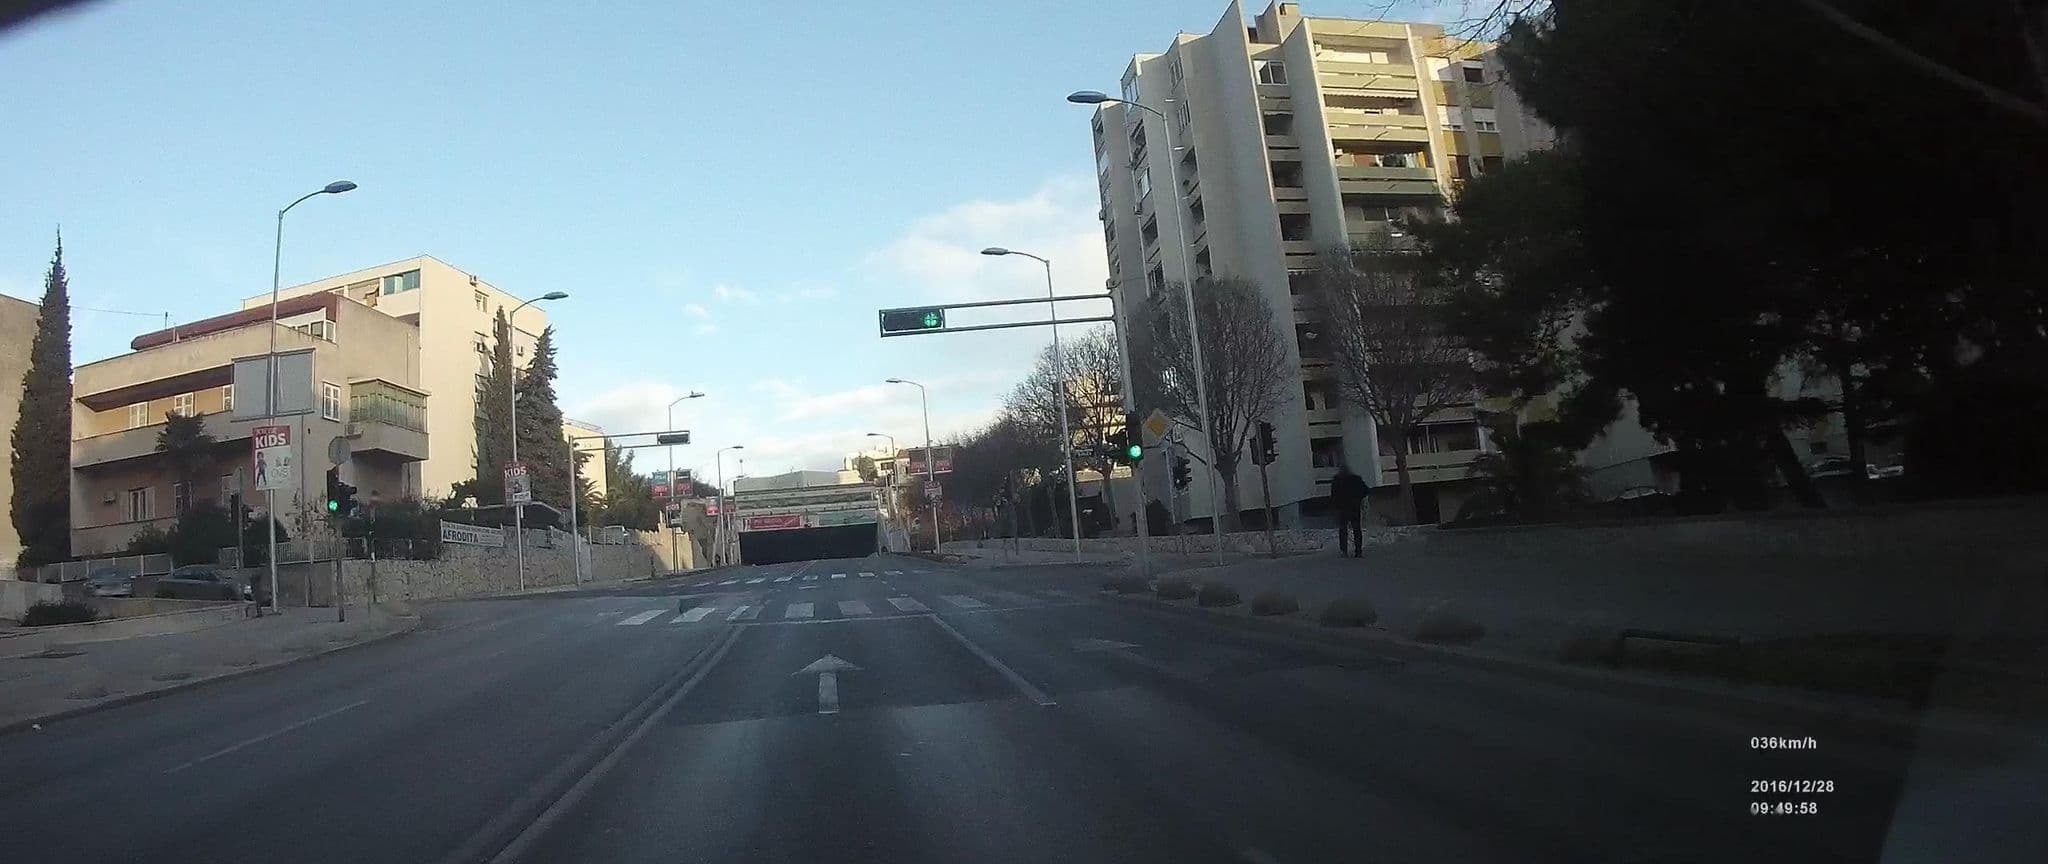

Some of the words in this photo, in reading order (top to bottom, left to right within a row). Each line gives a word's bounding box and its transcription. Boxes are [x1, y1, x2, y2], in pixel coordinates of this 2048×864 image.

[255, 433, 287, 449] KIDS
[504, 466, 527, 478] KIDS
[443, 529, 479, 543] AFRODITA
